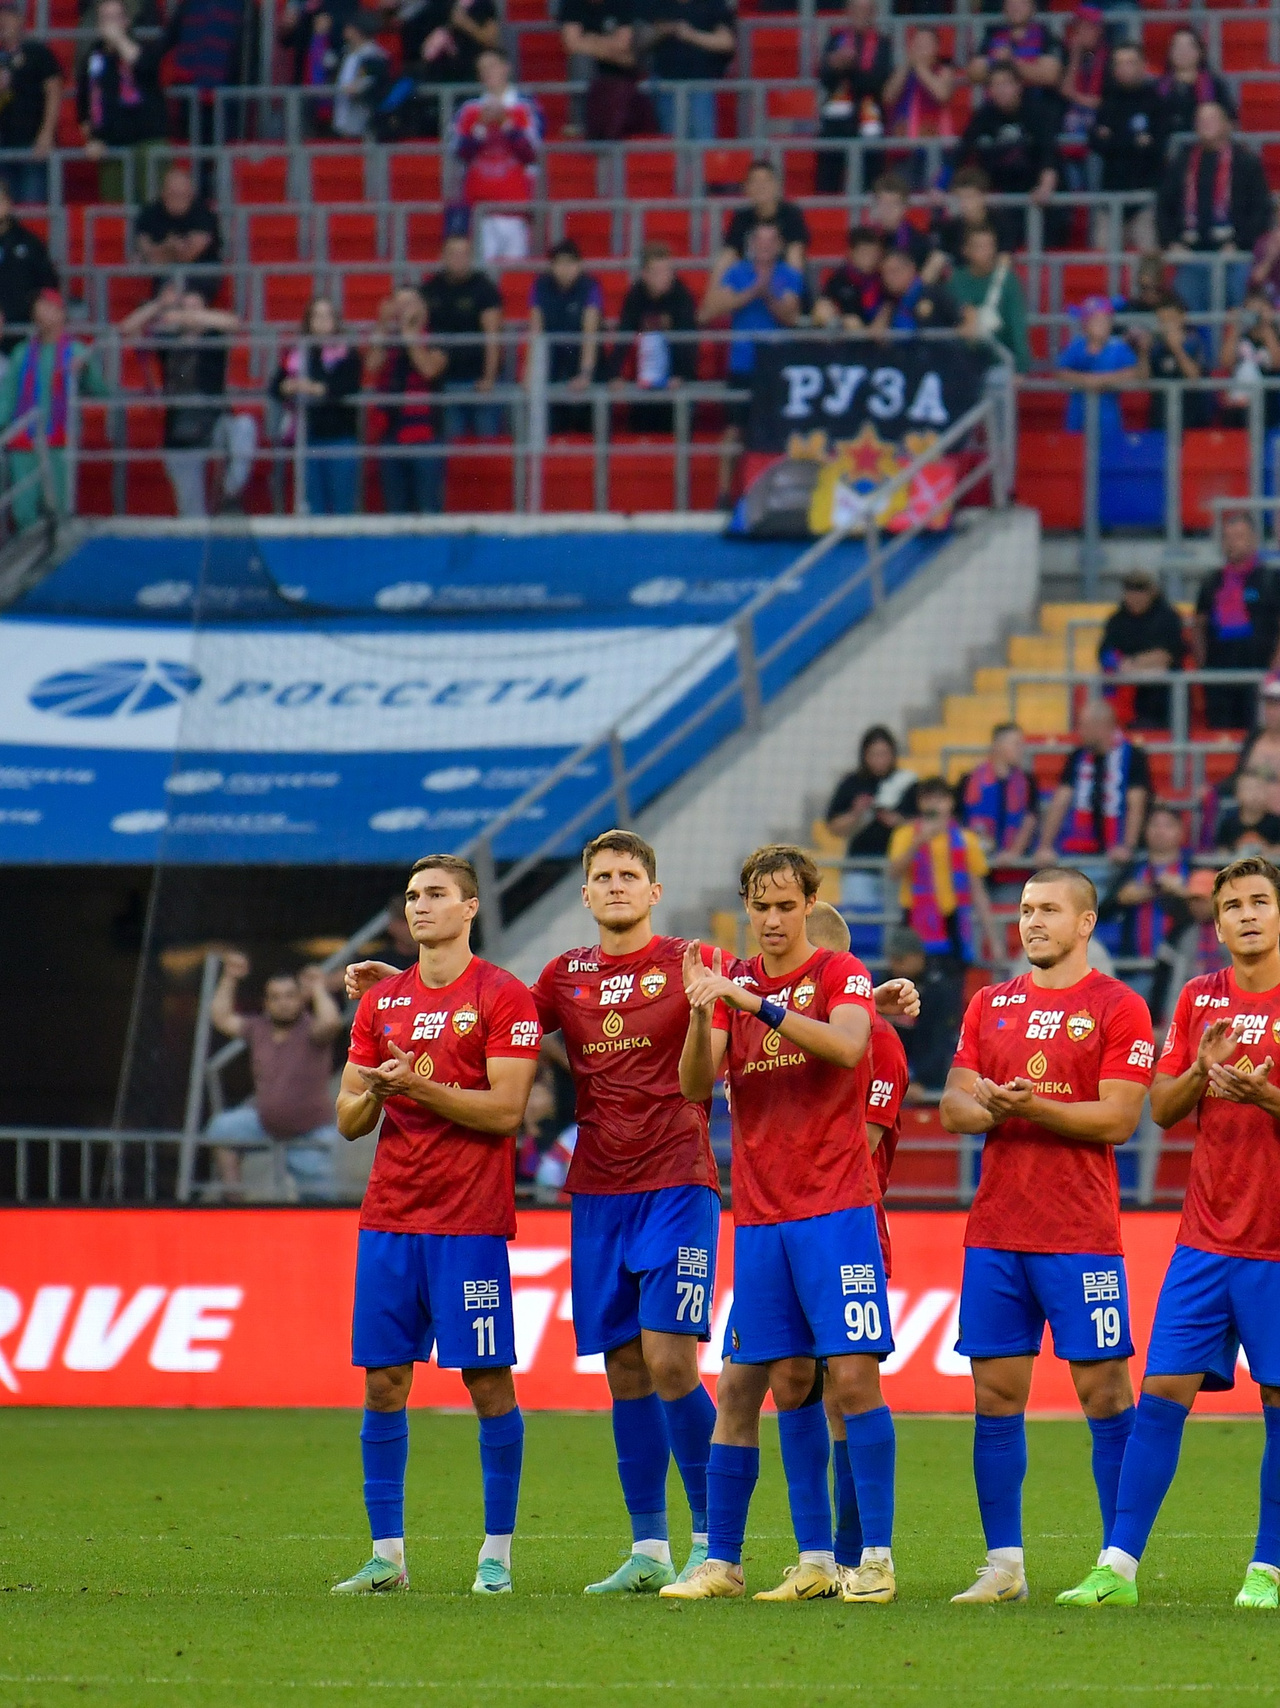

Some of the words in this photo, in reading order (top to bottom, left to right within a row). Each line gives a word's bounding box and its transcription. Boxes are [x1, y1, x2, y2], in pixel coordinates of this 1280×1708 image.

[782, 364, 948, 424] РУЗА
[220, 675, 588, 707] РОССЕТИ
[580, 962, 599, 972] ПСБ
[600, 974, 634, 991] FON
[846, 975, 871, 989] FON
[599, 988, 634, 1006] BET
[844, 983, 871, 998] BET
[413, 1011, 448, 1027] FON
[1028, 1010, 1064, 1025] FON
[1232, 1014, 1268, 1028] FON
[411, 1024, 446, 1040] BET
[512, 1021, 548, 1035] FON
[1026, 1024, 1061, 1040] BET
[511, 1033, 549, 1047] BET
[1236, 1030, 1266, 1044] ET
[583, 1036, 652, 1055] APOTHEKA
[1130, 1039, 1155, 1057] FON
[742, 1052, 806, 1076] APOTHEKA
[1127, 1052, 1155, 1068] BET
[872, 1080, 894, 1095] ON
[869, 1093, 892, 1108] ET
[678, 1246, 708, 1262] ВЭБ
[677, 1263, 708, 1278] РФ
[840, 1264, 875, 1278] ВЭБ
[1082, 1270, 1118, 1286] ВЭБ
[464, 1280, 499, 1294] ВЭБ
[842, 1282, 876, 1296] РФ
[464, 1297, 500, 1311] РФ
[676, 1281, 705, 1324] 78
[1084, 1288, 1120, 1304] РФ
[844, 1301, 882, 1340] 90
[1091, 1307, 1120, 1348] 19
[0, 1284, 244, 1393] IVE
[472, 1316, 496, 1356] 11
